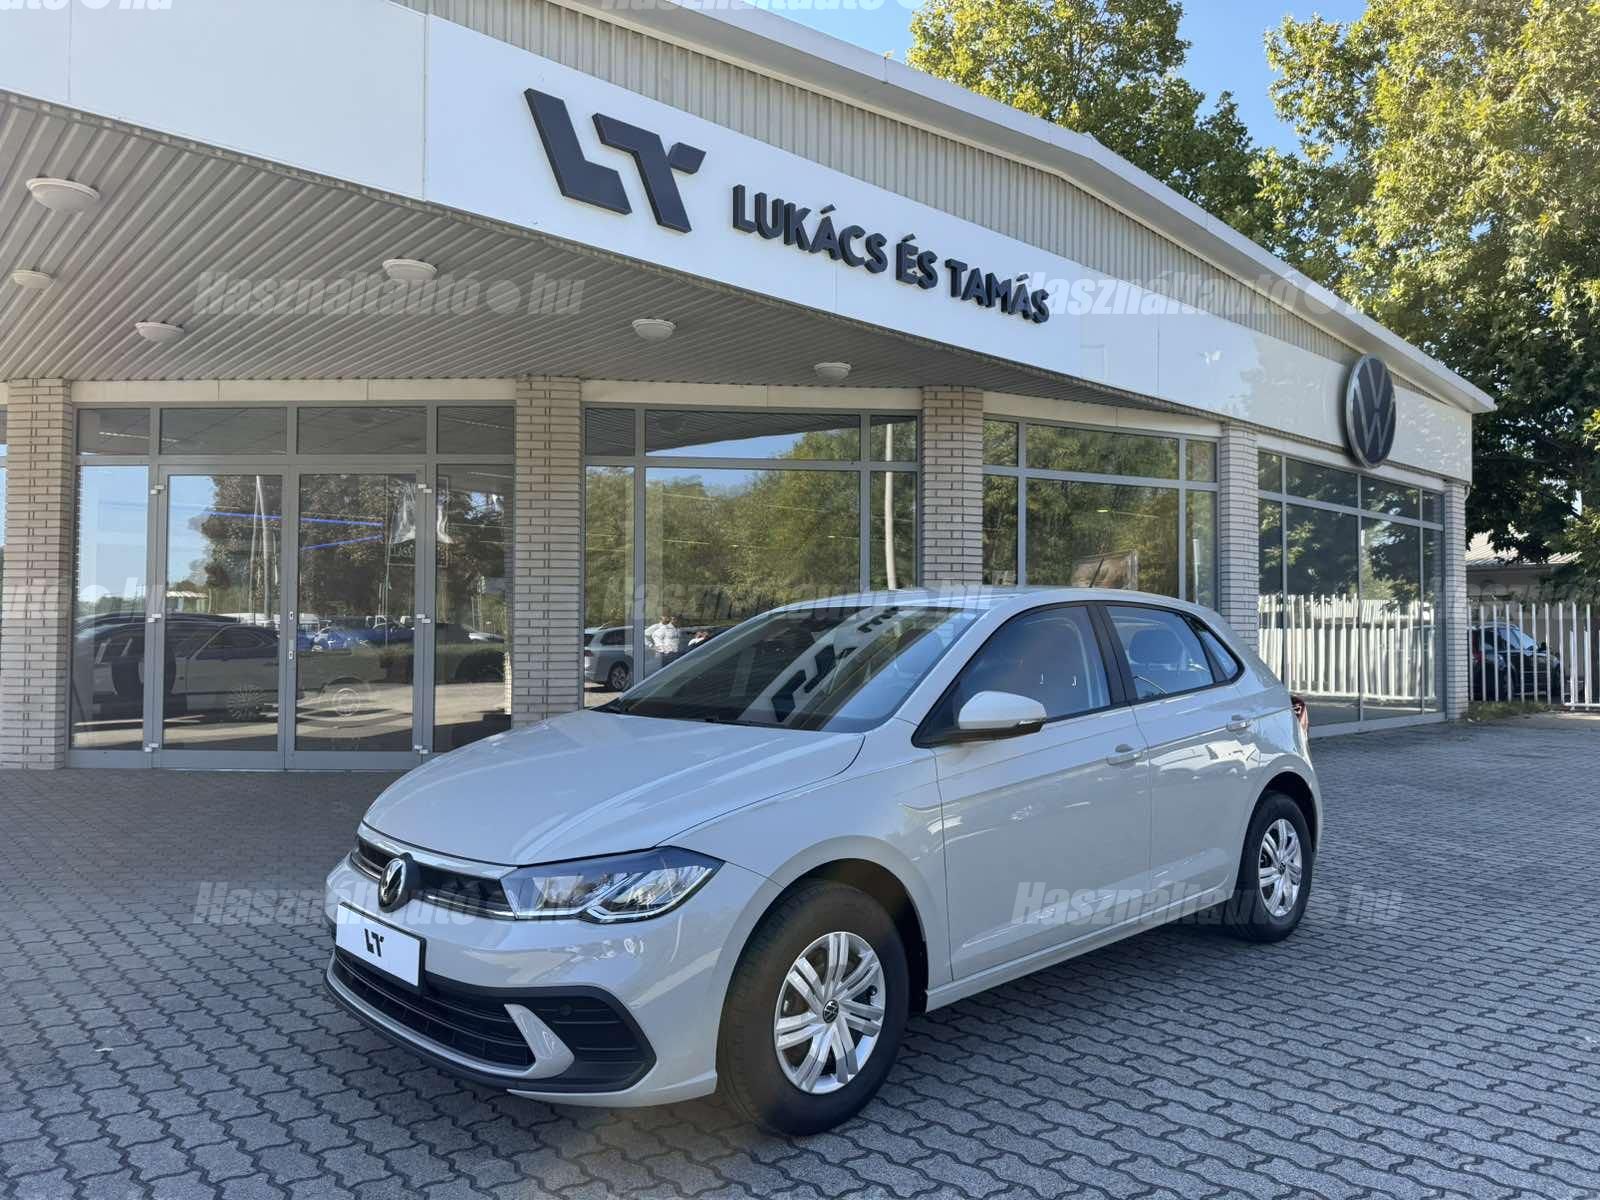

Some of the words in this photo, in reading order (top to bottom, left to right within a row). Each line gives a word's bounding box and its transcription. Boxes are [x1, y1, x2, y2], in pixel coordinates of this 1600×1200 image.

[732, 184, 889, 274] LUKÁCS
[896, 233, 939, 290] ÉS
[945, 258, 1050, 324] TAMÁS
